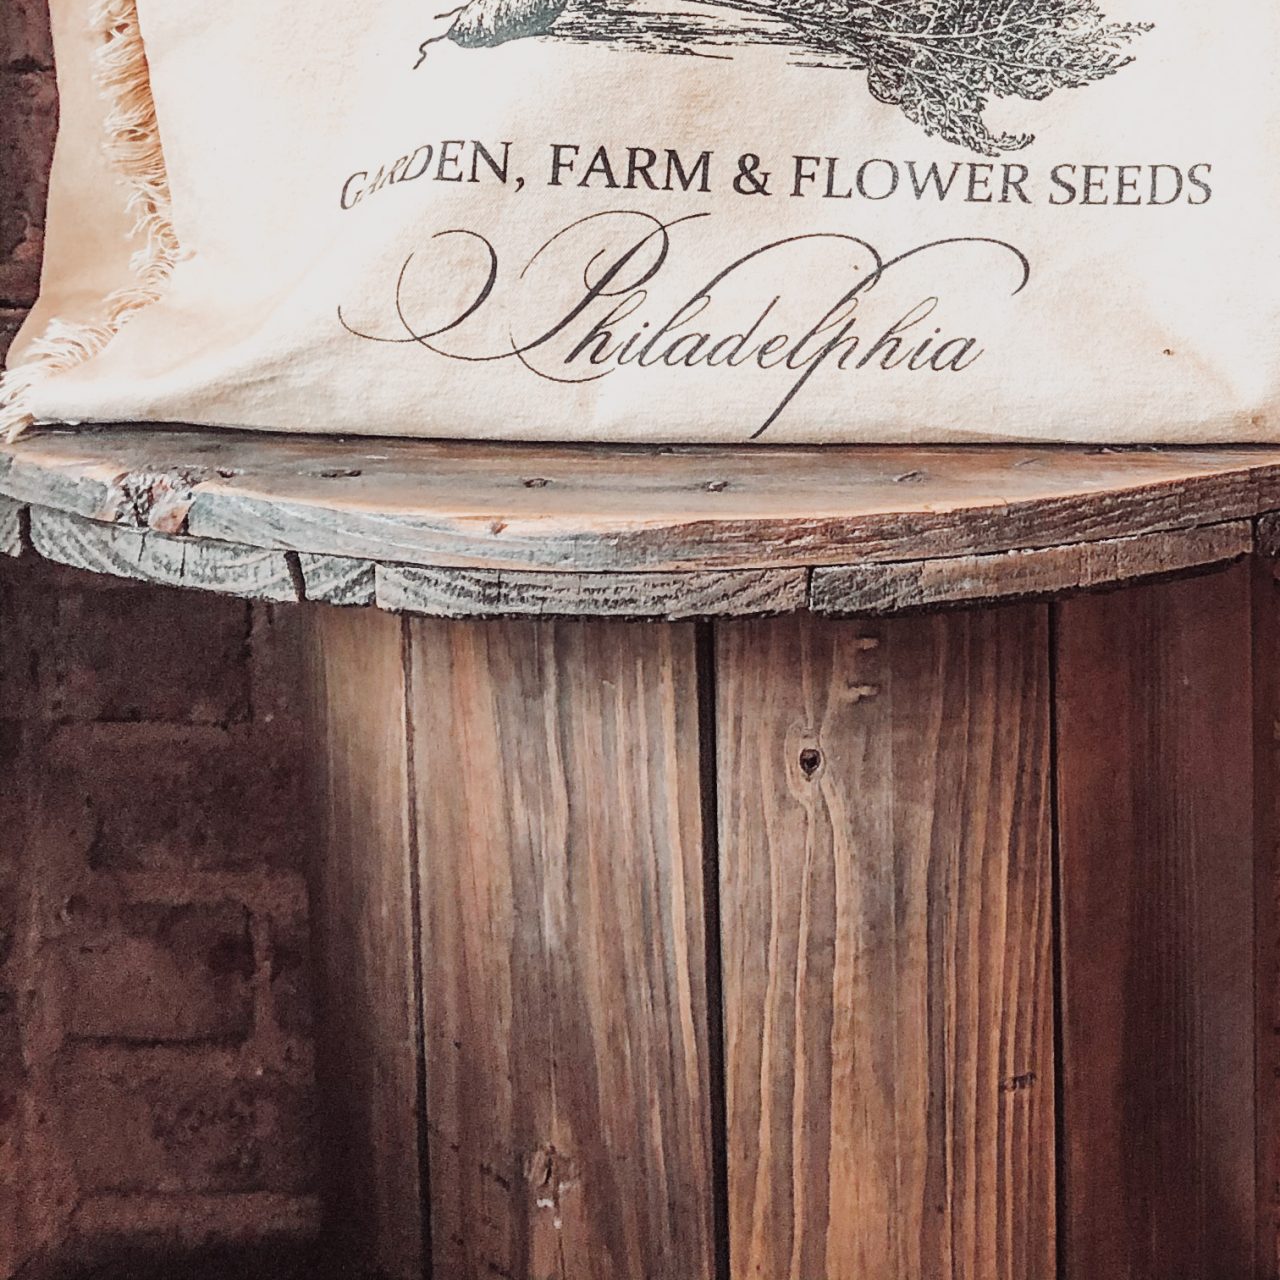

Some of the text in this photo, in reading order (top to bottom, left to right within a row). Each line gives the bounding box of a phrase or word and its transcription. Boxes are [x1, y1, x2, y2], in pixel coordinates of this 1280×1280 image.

[546, 143, 712, 193] FARM
[732, 151, 773, 196] &
[788, 155, 1032, 204] FLOWER
[1048, 162, 1213, 206] SEEDS
[338, 210, 1031, 440] Philadelphia
